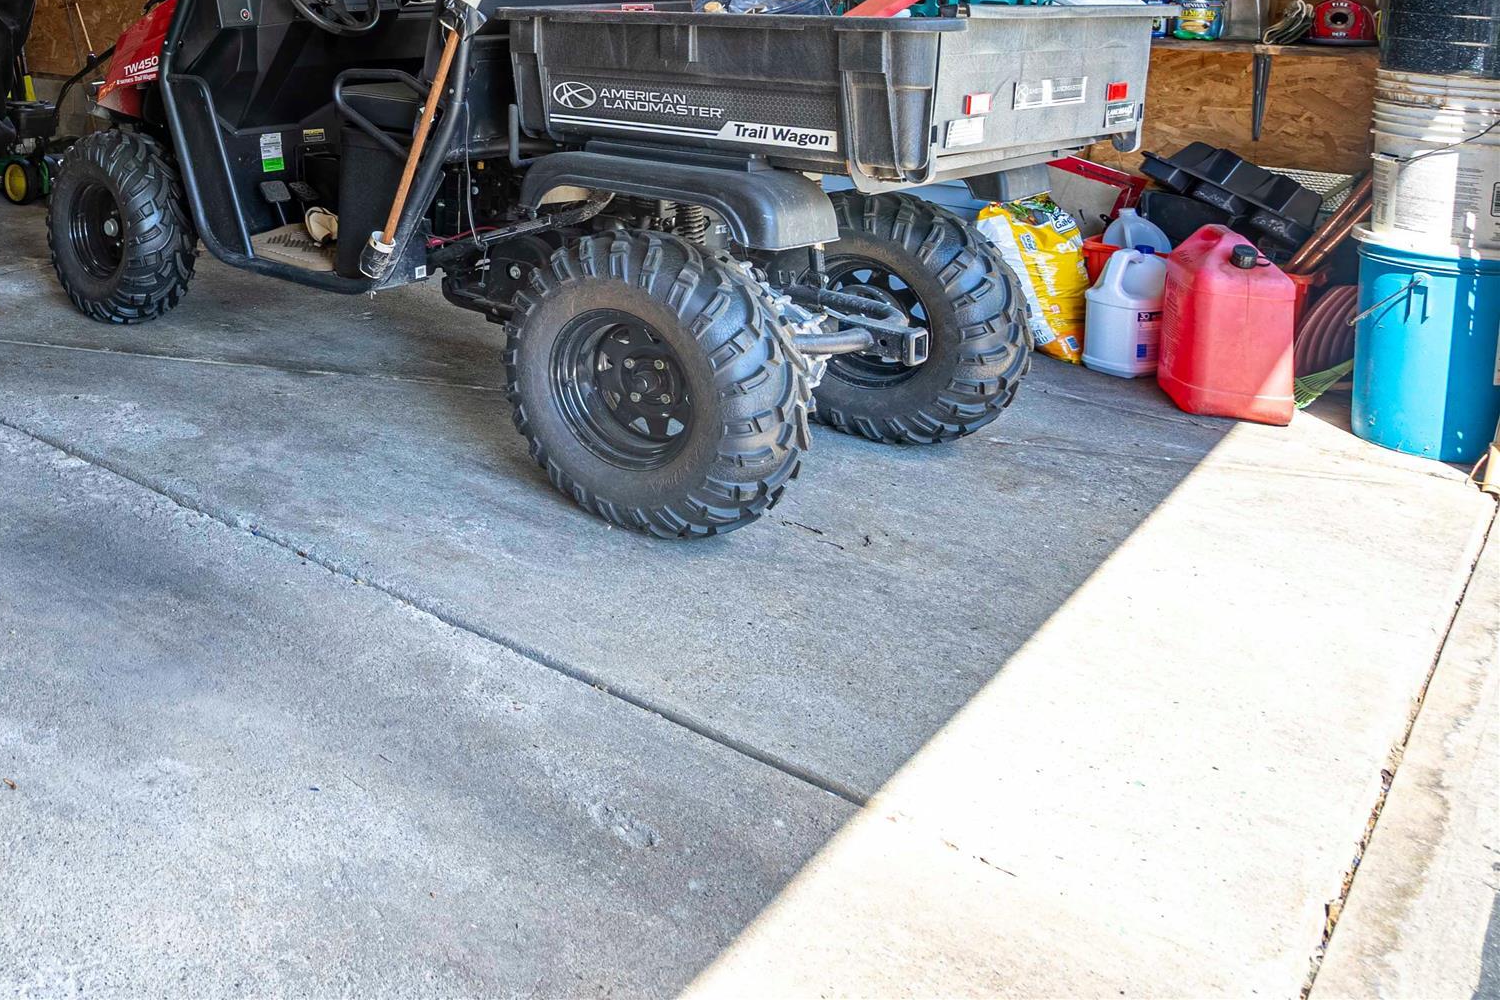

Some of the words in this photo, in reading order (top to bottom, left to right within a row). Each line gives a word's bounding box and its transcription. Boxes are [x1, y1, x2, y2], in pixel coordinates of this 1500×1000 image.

[124, 56, 159, 76] TW450
[600, 87, 687, 105] AMERICAN
[603, 98, 724, 119] LANDMASTER
[733, 123, 768, 140] Trail
[772, 127, 830, 147] Wagon
